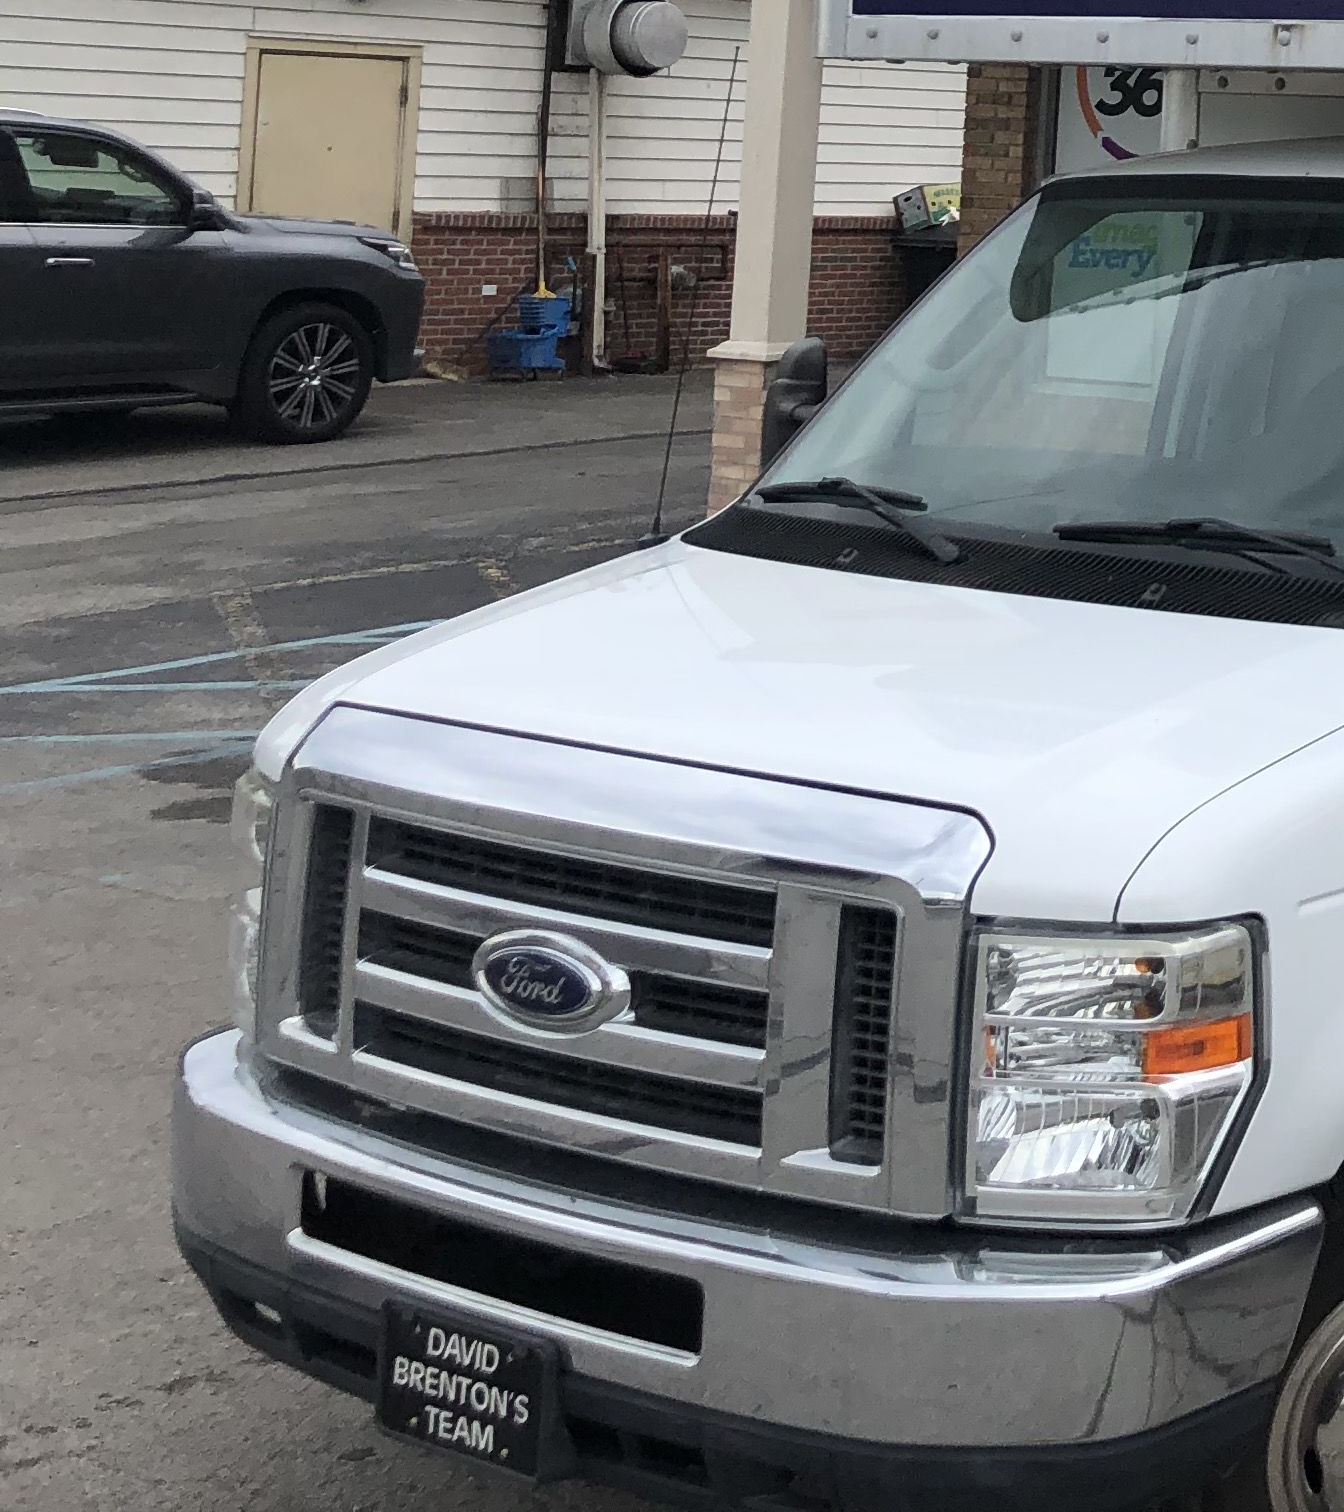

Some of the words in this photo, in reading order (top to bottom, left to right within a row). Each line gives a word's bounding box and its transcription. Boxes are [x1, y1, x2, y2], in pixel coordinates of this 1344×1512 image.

[1094, 66, 1163, 118] 36
[501, 956, 564, 1004] Ford
[426, 1327, 500, 1375] DAVID
[392, 1355, 530, 1424] BRENTON'S
[424, 1404, 494, 1454] TEAM
